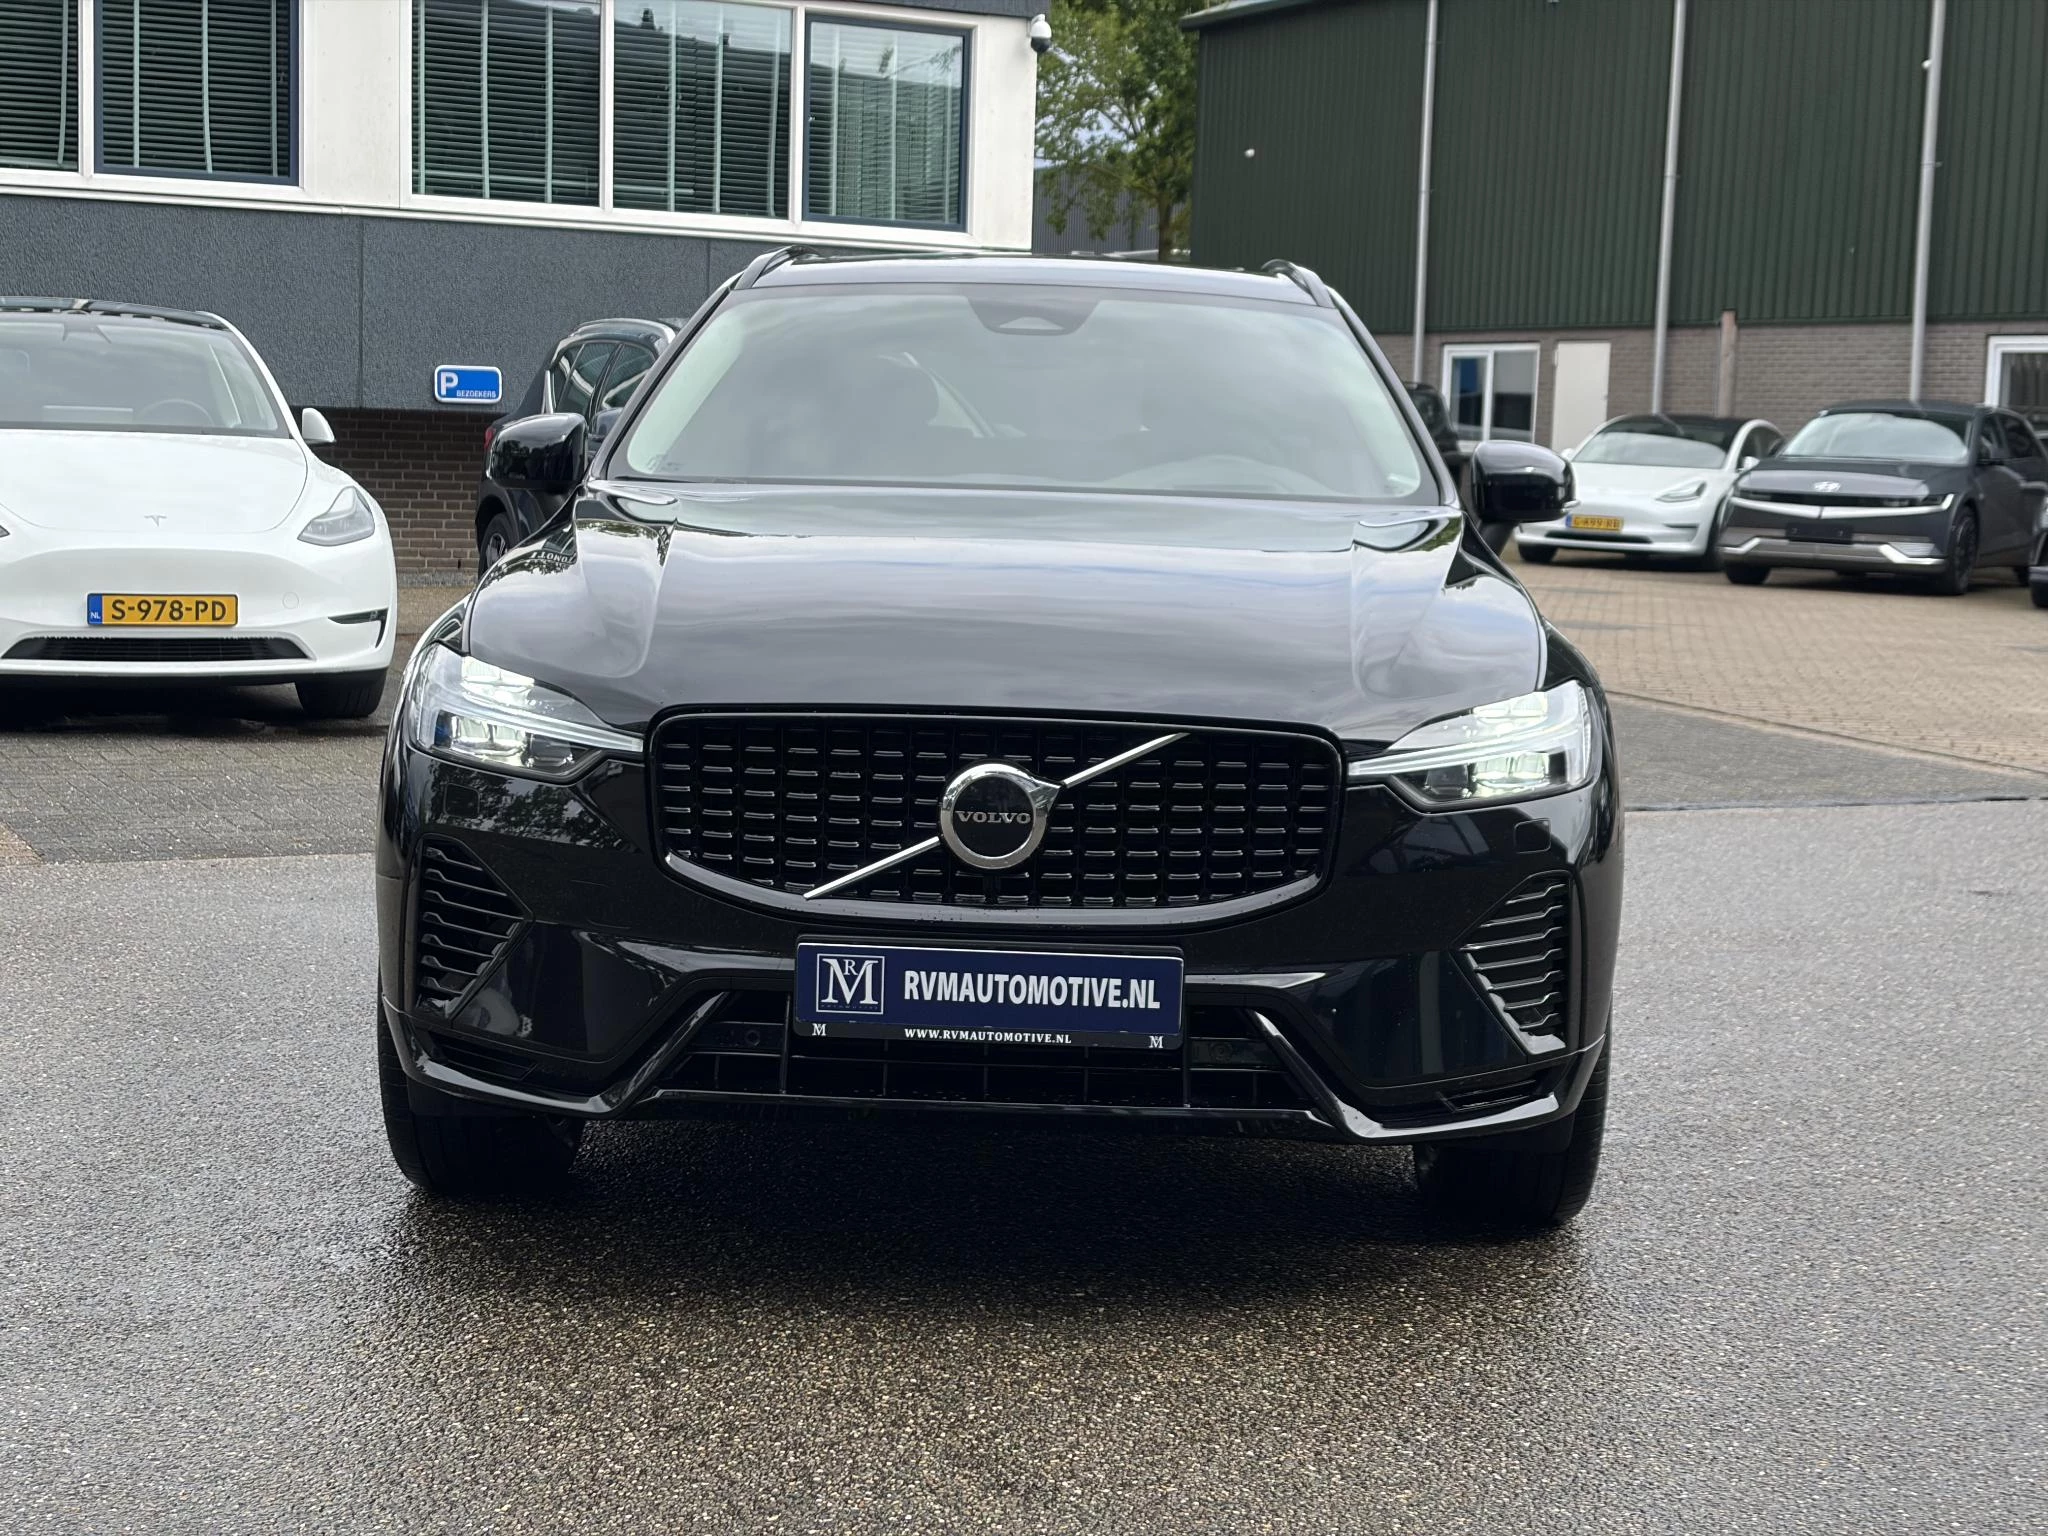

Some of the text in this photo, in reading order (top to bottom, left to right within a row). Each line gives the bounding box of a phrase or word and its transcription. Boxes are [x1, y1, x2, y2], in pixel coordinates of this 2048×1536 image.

[440, 371, 459, 396] P
[90, 611, 101, 620] NL
[111, 599, 227, 621] S-978-PD
[955, 810, 1032, 824] VOLVO
[904, 969, 1161, 1010] RVMAUTOMOTIVE.NL
[904, 1028, 1072, 1045] WWW.RVMAUTOMOTIVE.NL
